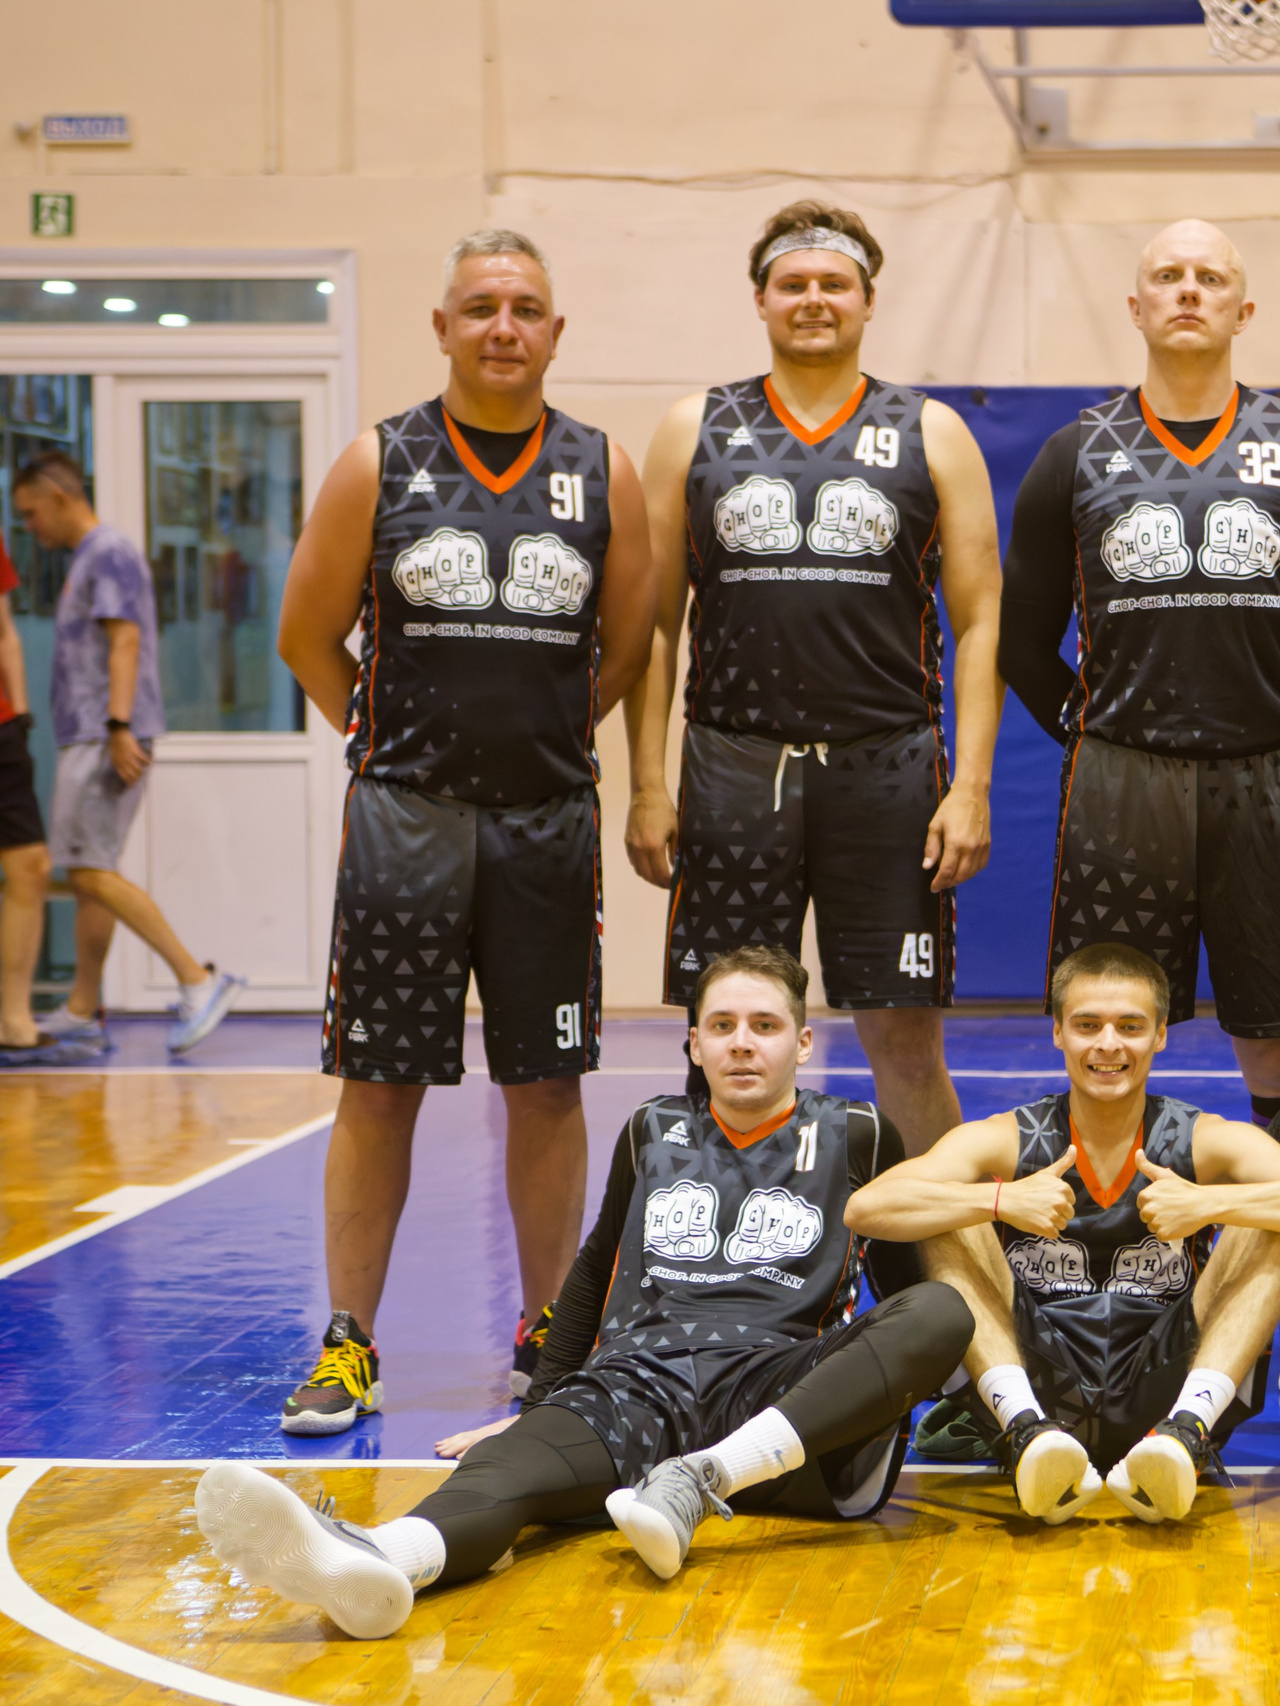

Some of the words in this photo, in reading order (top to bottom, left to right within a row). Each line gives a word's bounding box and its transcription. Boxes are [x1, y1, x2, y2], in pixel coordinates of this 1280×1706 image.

[854, 425, 900, 468] 49
[550, 472, 584, 522] 91
[782, 567, 797, 580] IN
[798, 568, 835, 580] GOOD
[836, 570, 891, 585] COMPANY
[1175, 594, 1190, 607] IN
[1191, 594, 1228, 606] GOOD
[475, 624, 492, 637] IN
[493, 625, 531, 640] GOOD
[532, 626, 581, 645] COMPANY
[899, 933, 934, 978] 49
[556, 1002, 582, 1050] 91
[650, 1206, 706, 1227] HOP
[688, 1273, 705, 1283] IN
[747, 1266, 806, 1289] OMPANY
